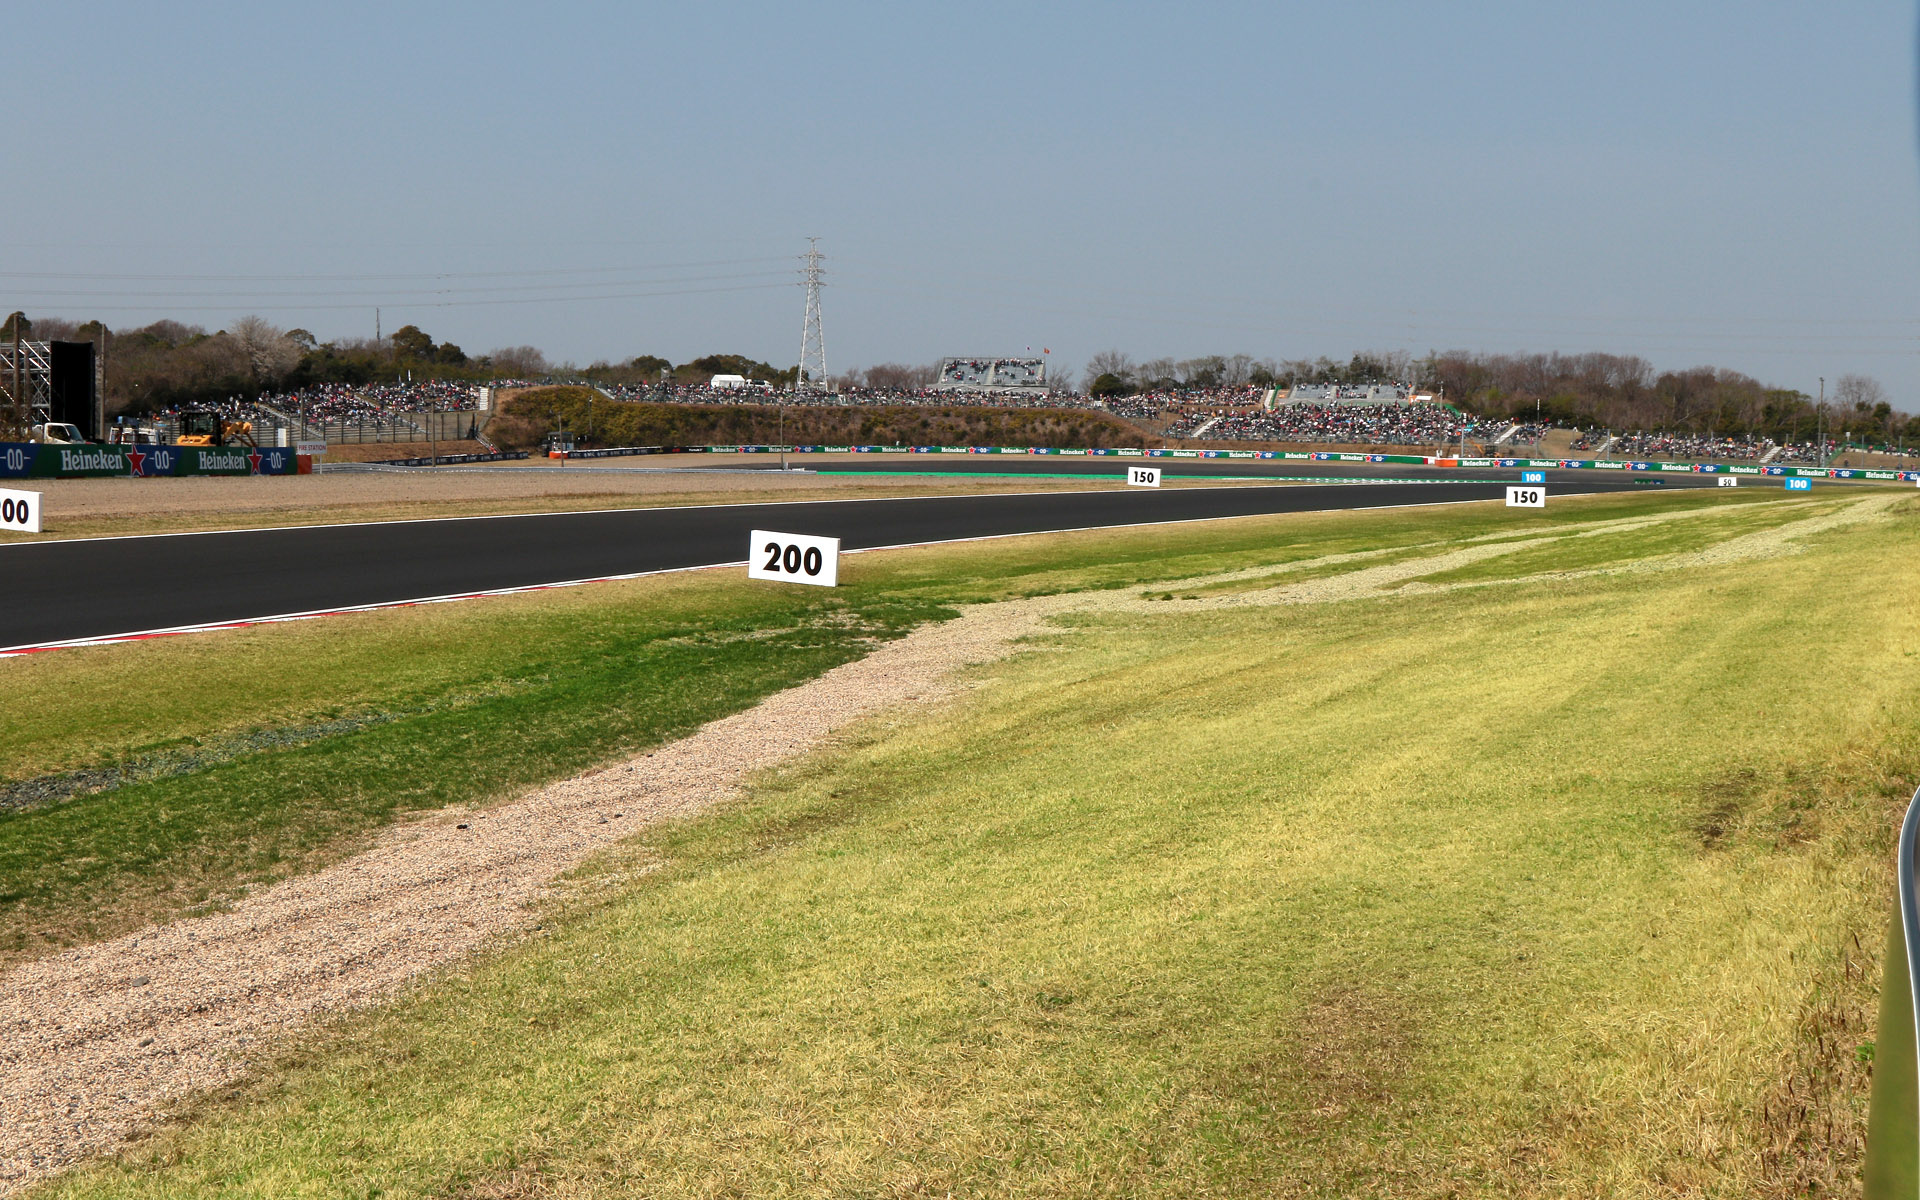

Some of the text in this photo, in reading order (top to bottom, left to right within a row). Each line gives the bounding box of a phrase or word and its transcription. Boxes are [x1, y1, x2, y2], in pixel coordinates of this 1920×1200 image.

[7, 448, 23, 470] 0.0
[61, 449, 169, 470] Heineken 0.0
[198, 451, 245, 469] Heineken
[1134, 471, 1154, 483] 150
[1525, 474, 1541, 482] 100
[1790, 480, 1807, 488] 100
[1514, 491, 1537, 503] 150
[0, 498, 28, 525] 00
[763, 542, 823, 576] 200
